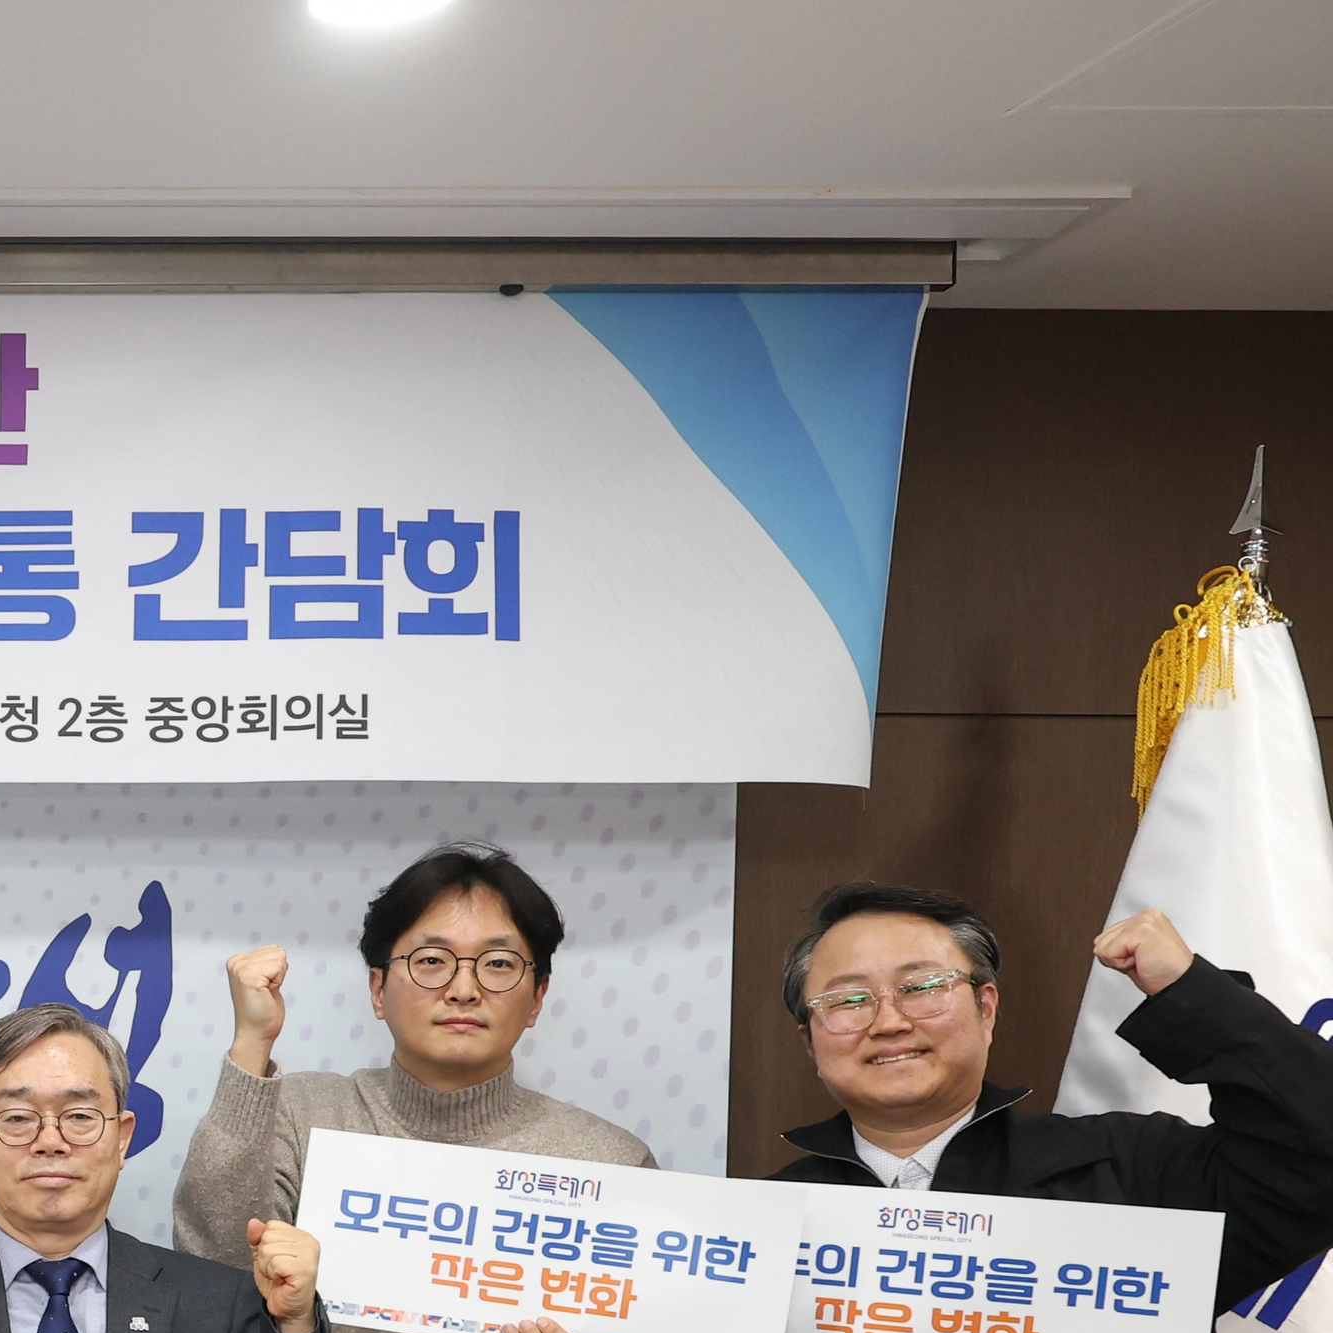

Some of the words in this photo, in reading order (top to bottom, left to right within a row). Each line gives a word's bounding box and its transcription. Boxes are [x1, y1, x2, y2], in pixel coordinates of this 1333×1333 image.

[128, 508, 520, 641] 간담회
[58, 696, 128, 743] 2층
[145, 694, 368, 743] 중앙회의실
[336, 1190, 477, 1245] 모두의
[493, 1210, 637, 1268] 건강을
[653, 1232, 756, 1284] 위한
[432, 1253, 523, 1305] 작은
[540, 1268, 638, 1319] 변화
[877, 1249, 1037, 1304] 건강을
[1054, 1264, 1169, 1316] 위한
